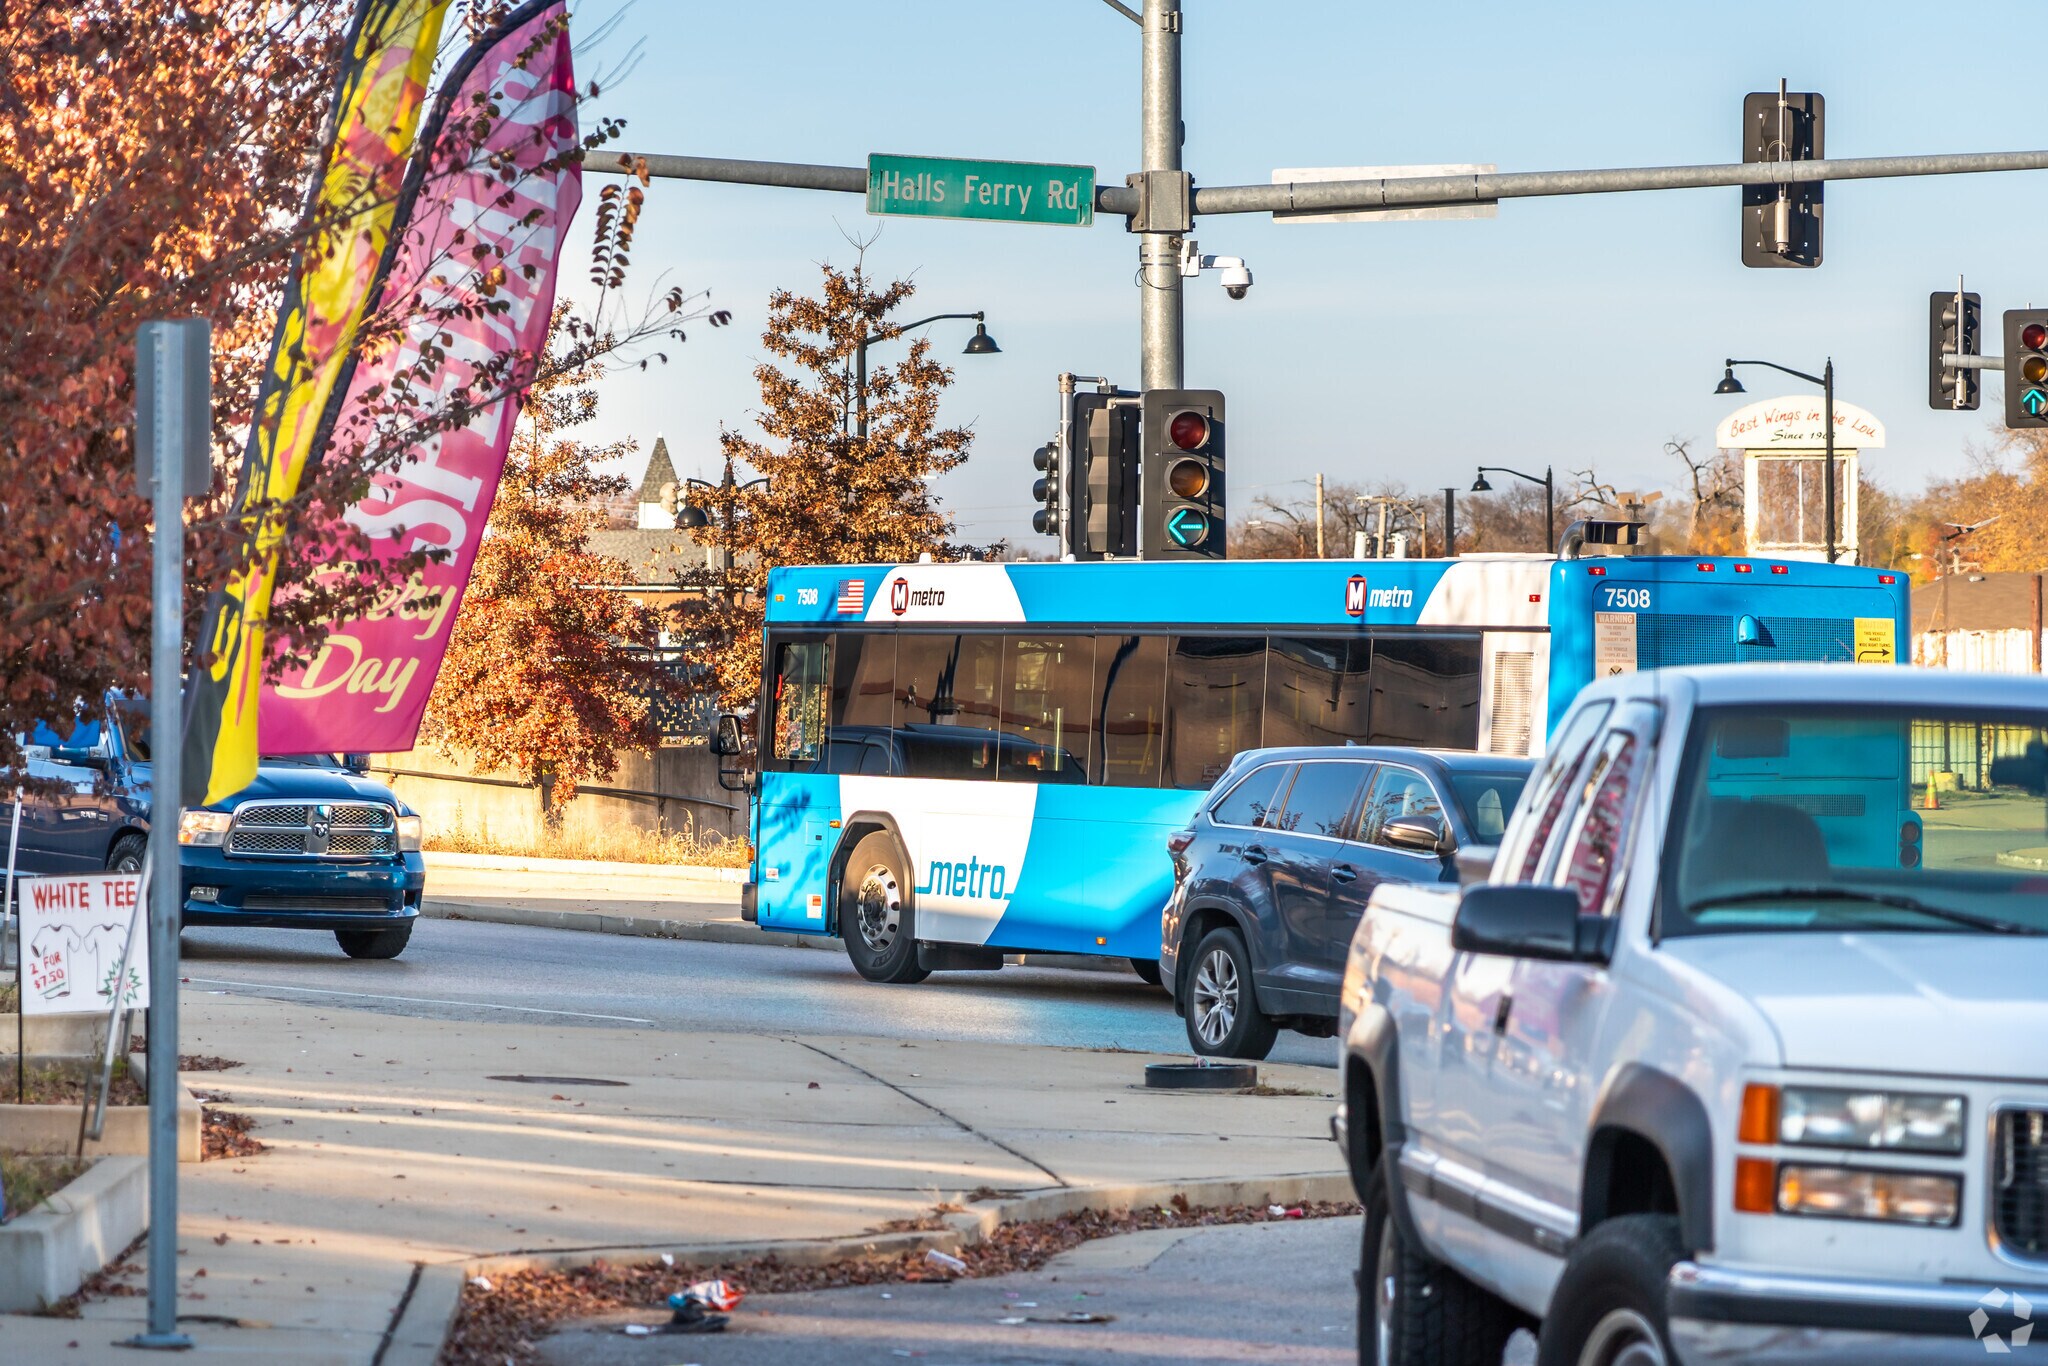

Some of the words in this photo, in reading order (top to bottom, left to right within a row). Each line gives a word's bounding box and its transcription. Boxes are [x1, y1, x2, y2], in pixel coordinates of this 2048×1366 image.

[884, 170, 945, 202] Halls
[964, 175, 1032, 214] Ferry
[1048, 180, 1078, 209] Rd
[1730, 418, 1758, 438] Best
[1765, 408, 1800, 427] Wings
[1807, 409, 1820, 420] in
[1851, 418, 1875, 438] Lou
[1770, 429, 1803, 442] Since
[797, 588, 819, 606] 7508
[911, 587, 945, 606] metro
[1369, 585, 1413, 608] metro
[1605, 588, 1651, 608] 7508
[1599, 614, 1633, 623] WARNING
[274, 634, 420, 713] Day
[915, 855, 1010, 900] metro
[32, 882, 90, 912] WHITE
[102, 881, 137, 909] TEE
[29, 962, 39, 975] 2
[43, 951, 62, 970] FOR
[34, 968, 65, 989] $7.50
